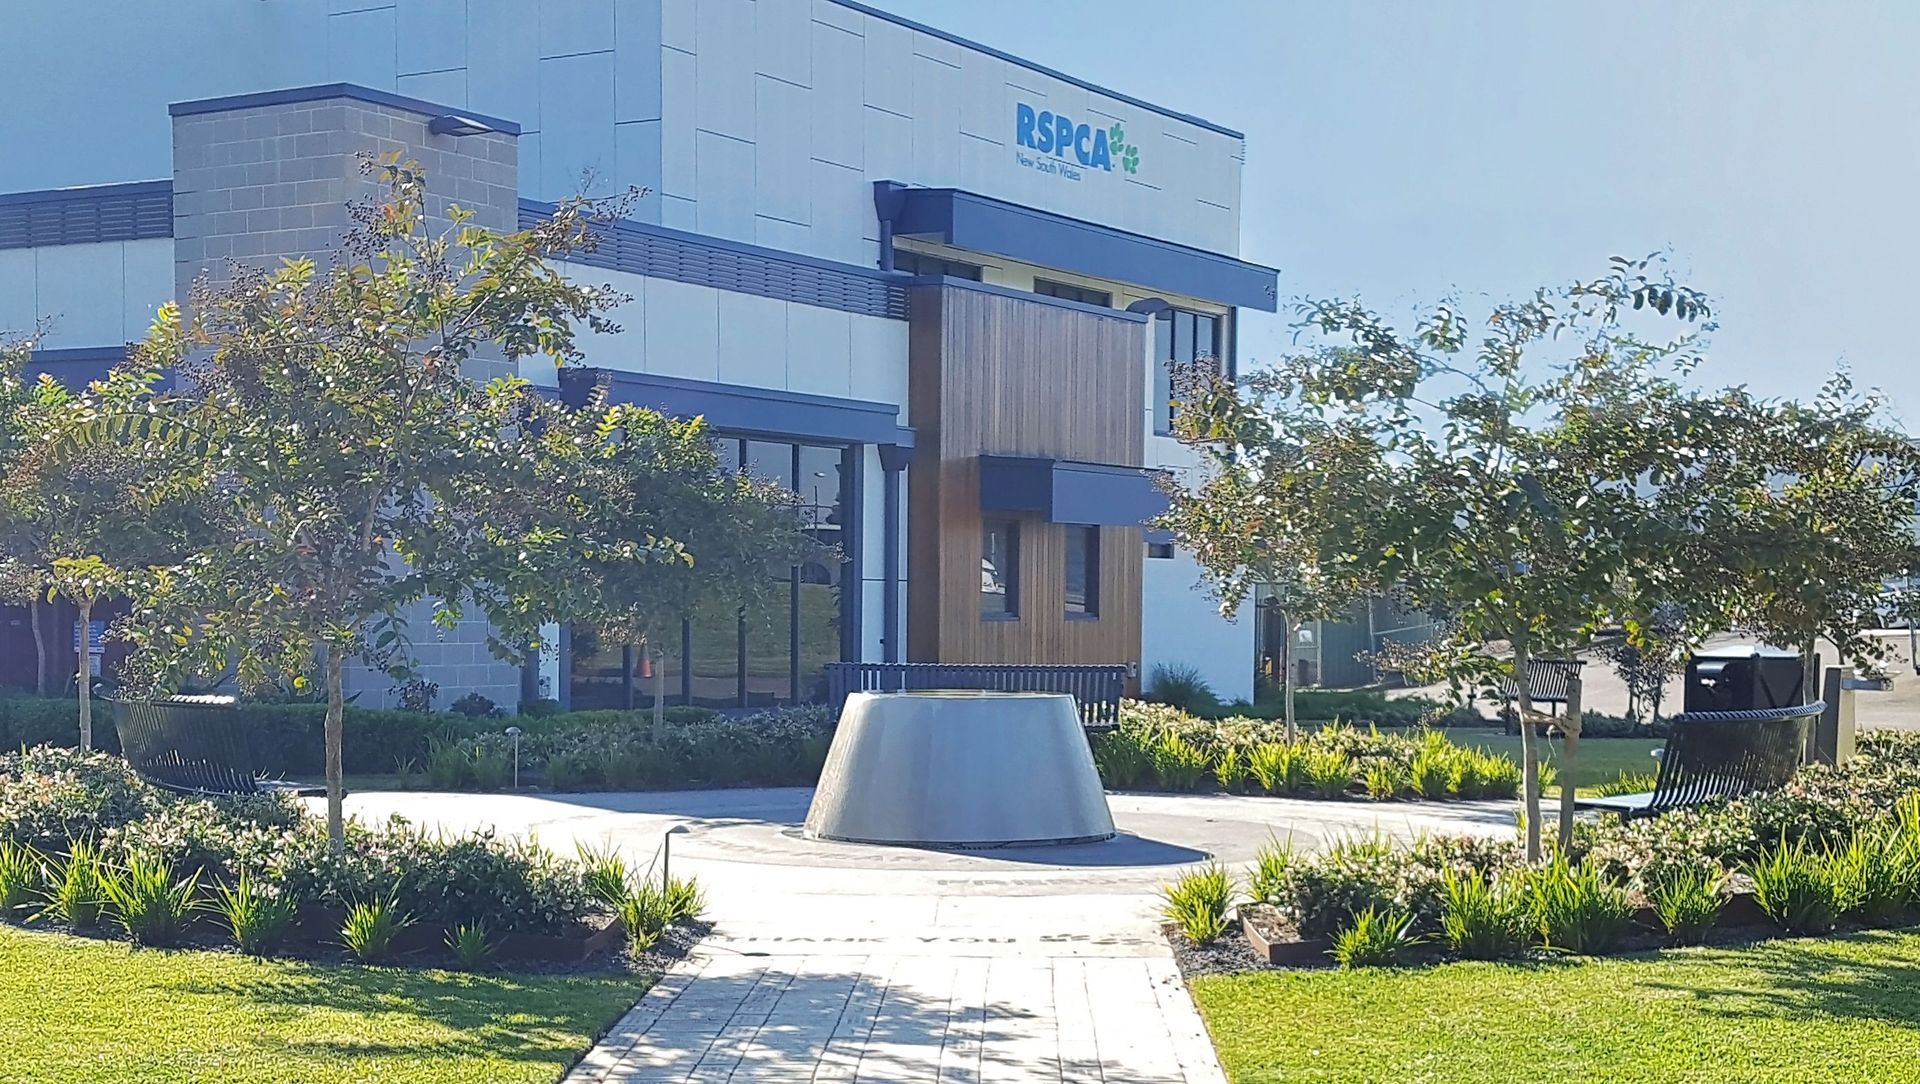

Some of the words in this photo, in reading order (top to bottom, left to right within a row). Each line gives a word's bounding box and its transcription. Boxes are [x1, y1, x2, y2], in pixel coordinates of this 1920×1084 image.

[1016, 102, 1112, 172] RSPCA
[1016, 151, 1034, 168] New
[1036, 156, 1057, 174] South
[1058, 162, 1082, 182] Wales
[915, 936, 1018, 944] YOU
